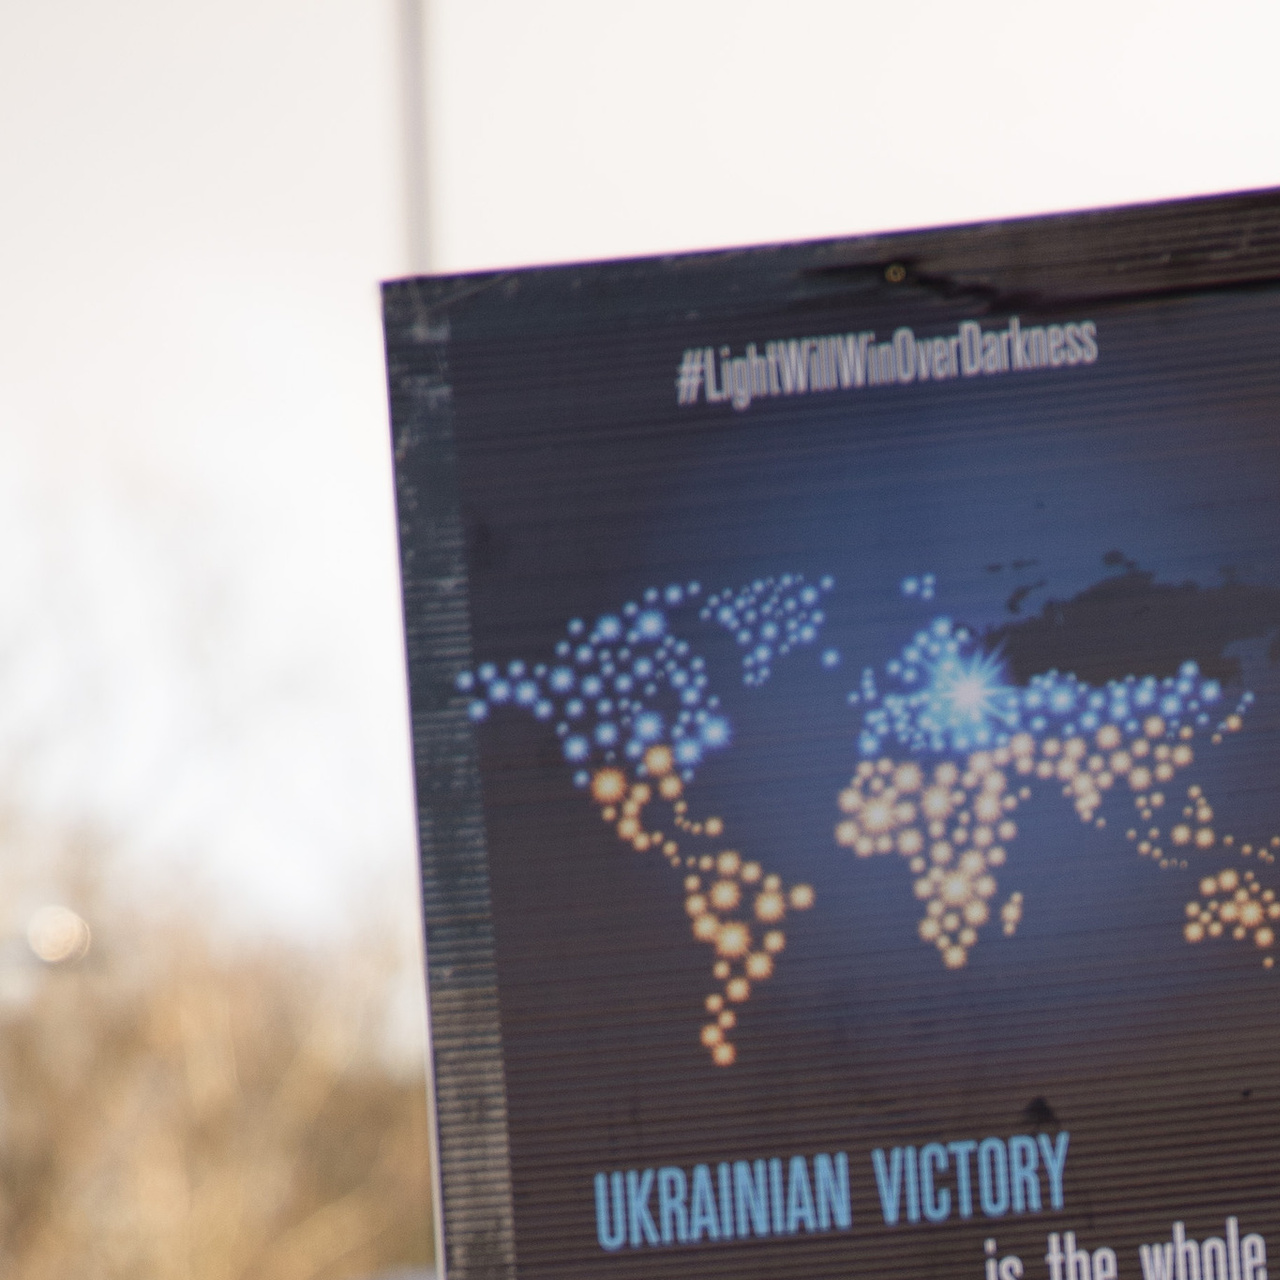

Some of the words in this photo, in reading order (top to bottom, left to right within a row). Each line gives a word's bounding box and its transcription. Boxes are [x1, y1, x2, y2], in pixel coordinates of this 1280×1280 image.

[677, 315, 1098, 411] #LightWillWinOverDarkness
[594, 1151, 851, 1251] UKRAINIAN
[872, 1131, 1069, 1226] VICTORY
